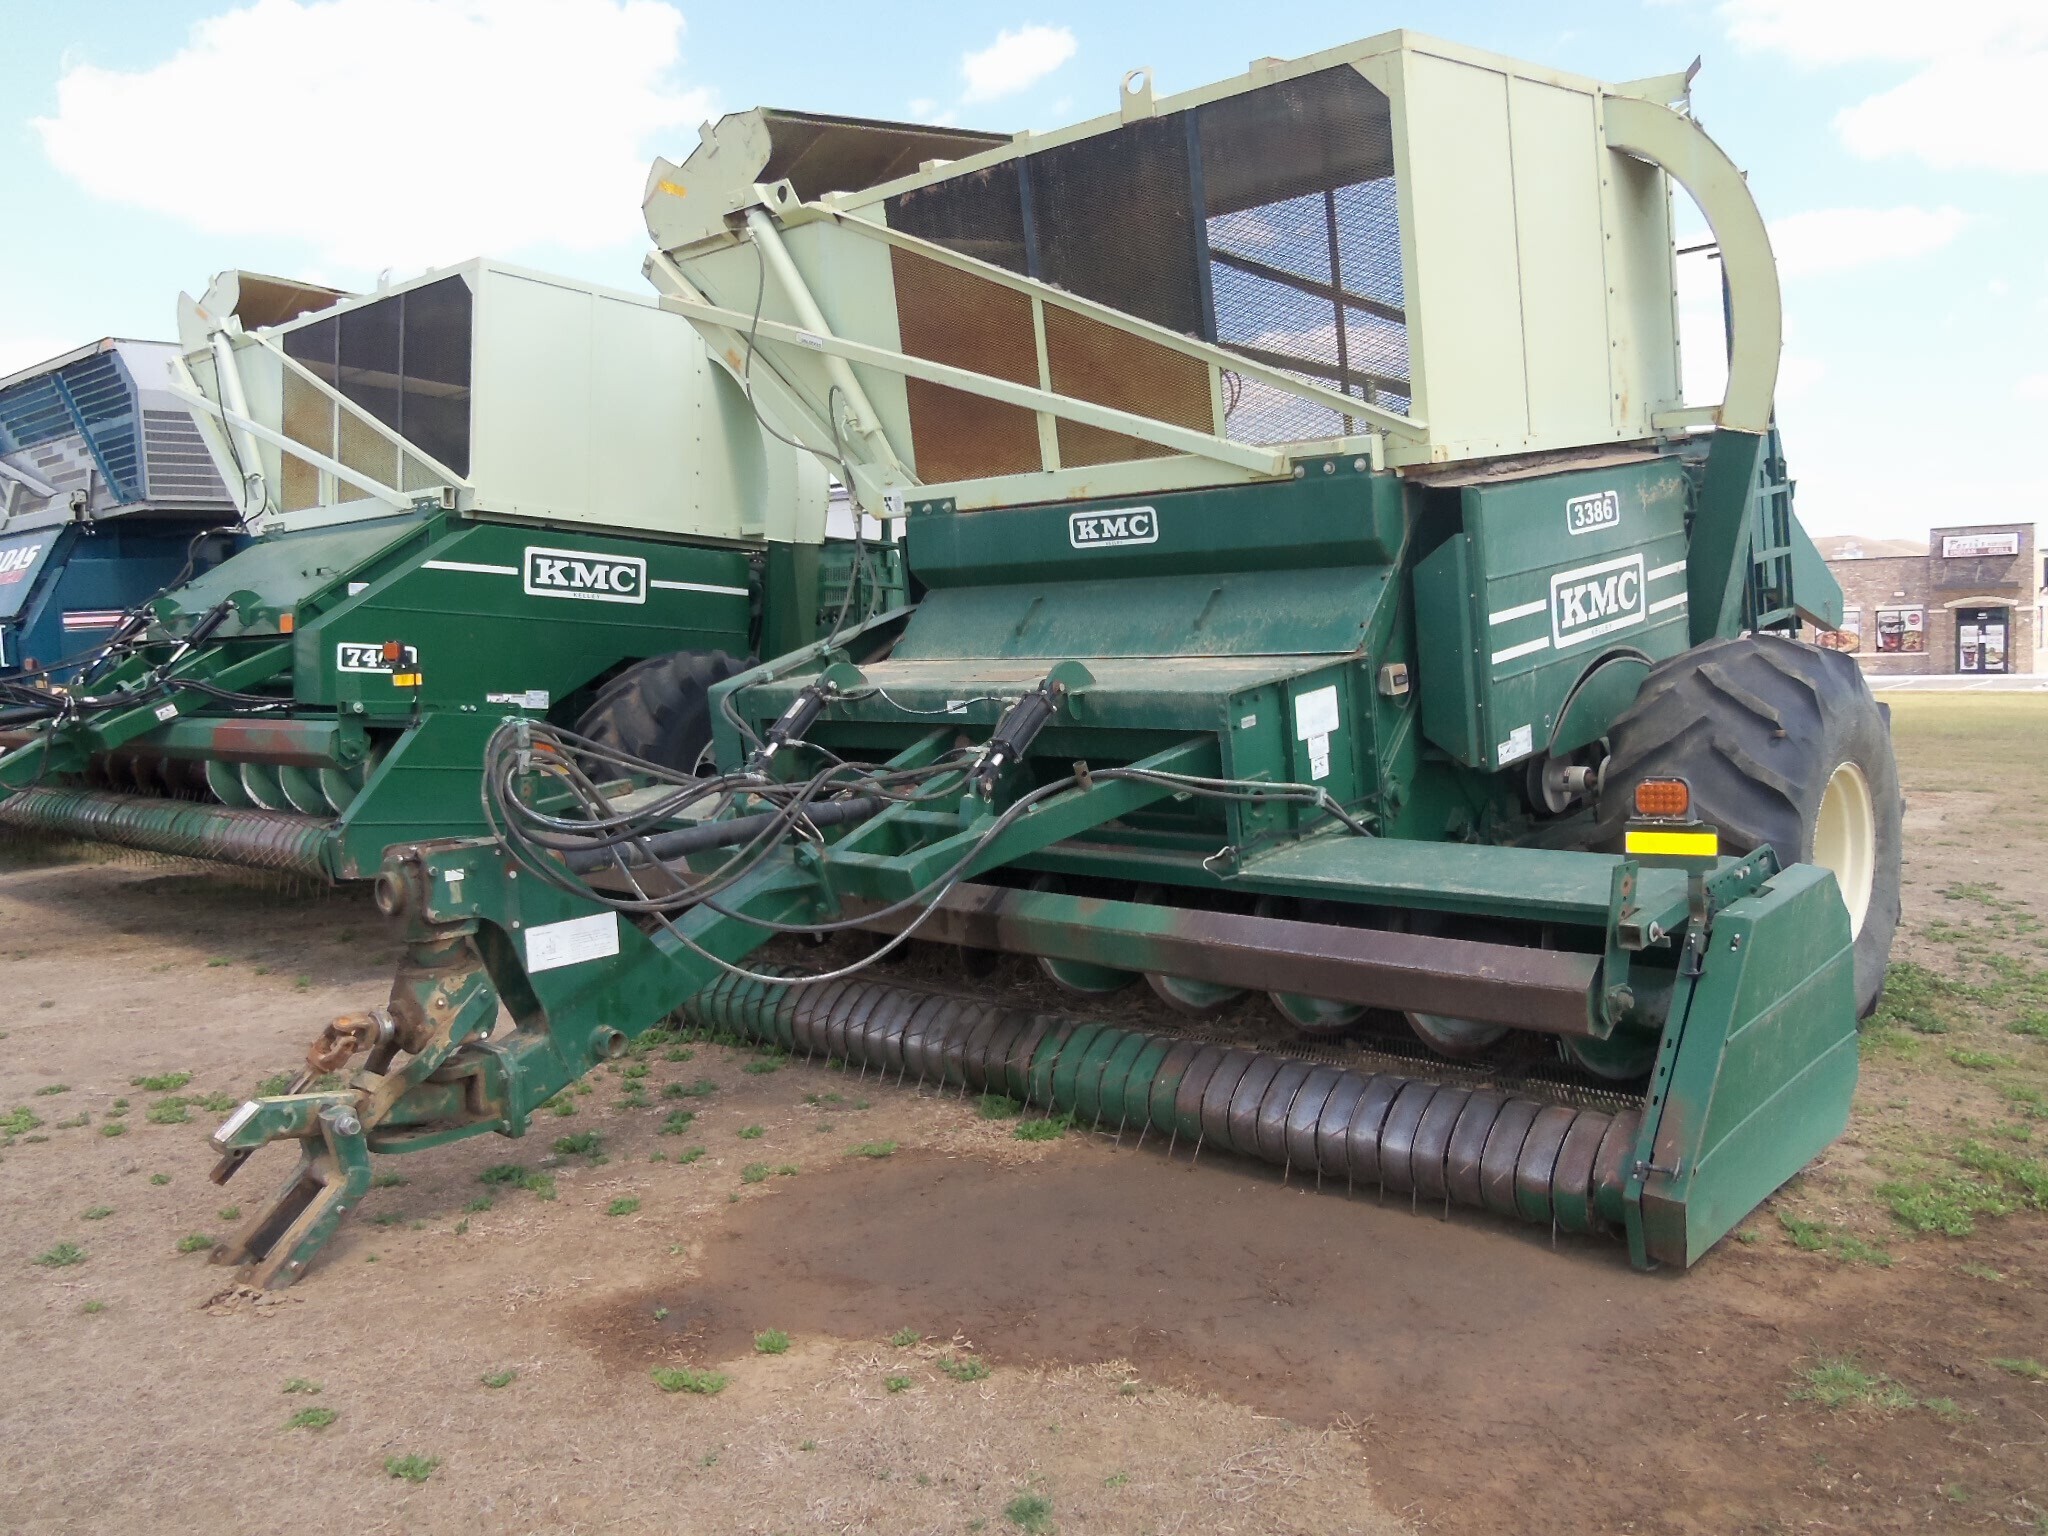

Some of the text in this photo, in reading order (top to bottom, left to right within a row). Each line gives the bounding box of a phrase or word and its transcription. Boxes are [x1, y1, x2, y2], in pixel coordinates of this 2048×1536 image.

[1574, 498, 1613, 527] 3386
[1077, 515, 1149, 540] KMC
[536, 558, 636, 592] KMC
[573, 592, 601, 600] KELLEY
[1560, 570, 1638, 629] KMC
